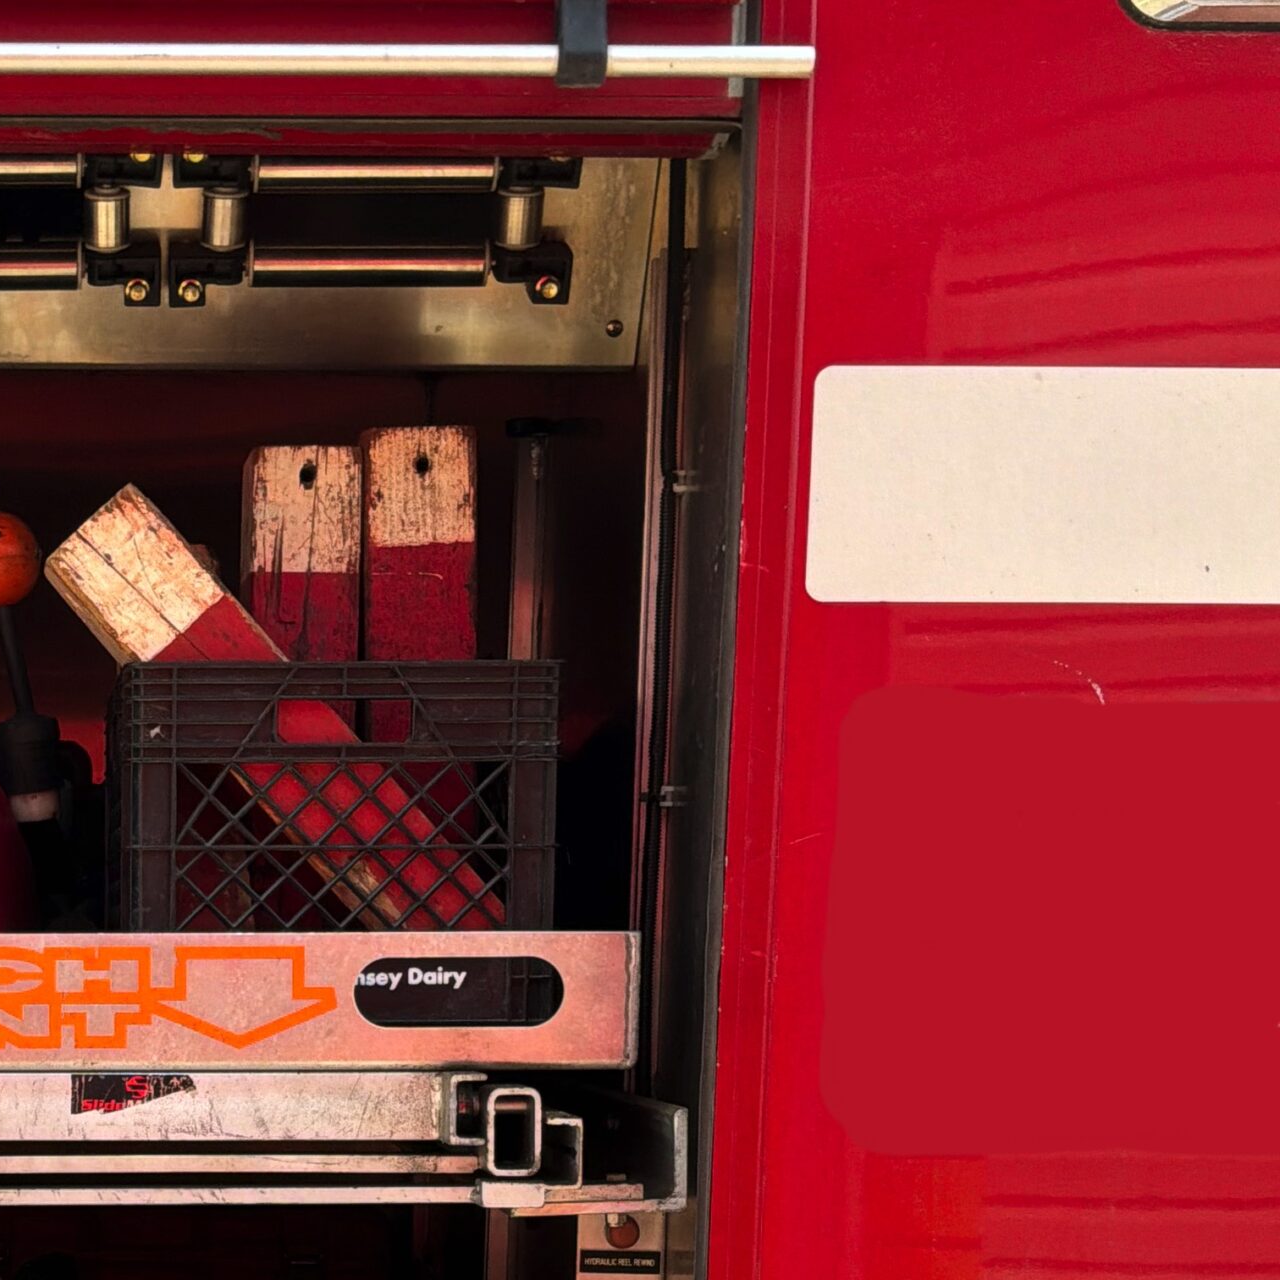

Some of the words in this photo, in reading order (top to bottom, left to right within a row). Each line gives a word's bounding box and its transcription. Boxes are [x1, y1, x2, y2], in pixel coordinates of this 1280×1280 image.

[407, 966, 467, 989] Dairy
[584, 1257, 617, 1266] HYDRAULIC
[618, 1258, 632, 1267] REEL
[633, 1258, 656, 1267] REWIND
